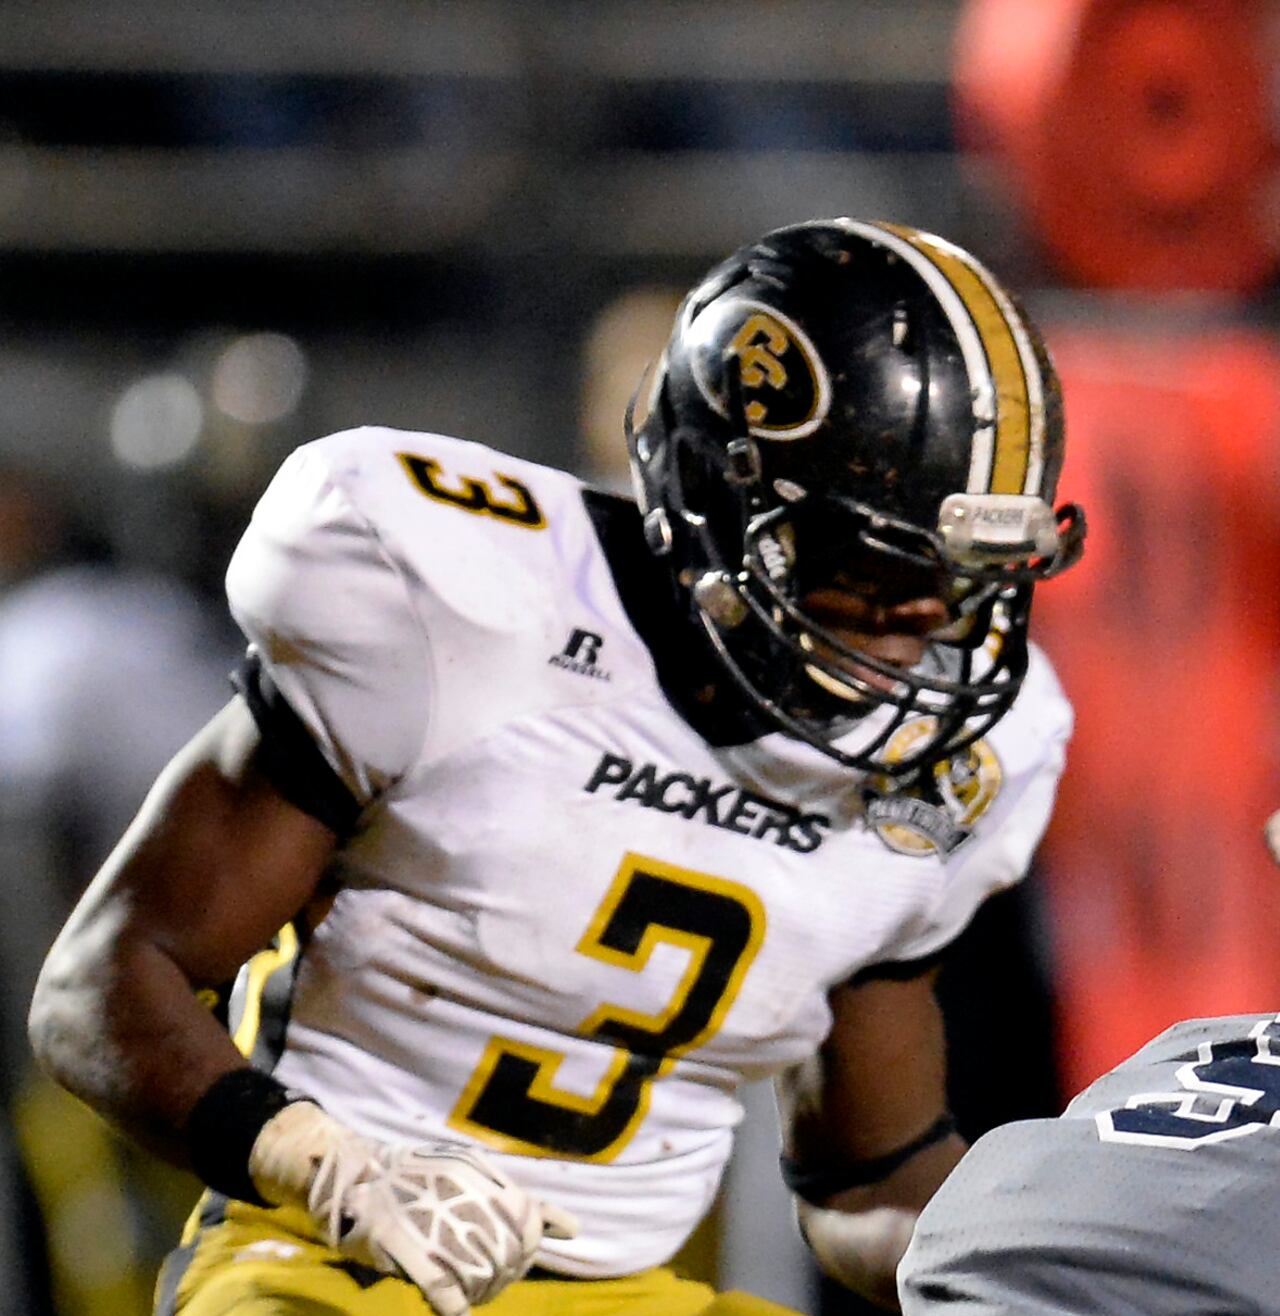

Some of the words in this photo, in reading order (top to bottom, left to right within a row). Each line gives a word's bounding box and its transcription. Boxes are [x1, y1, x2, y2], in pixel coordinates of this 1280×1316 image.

[396, 452, 548, 531] 3
[585, 751, 831, 853] PACKERS
[447, 850, 768, 1164] 3
